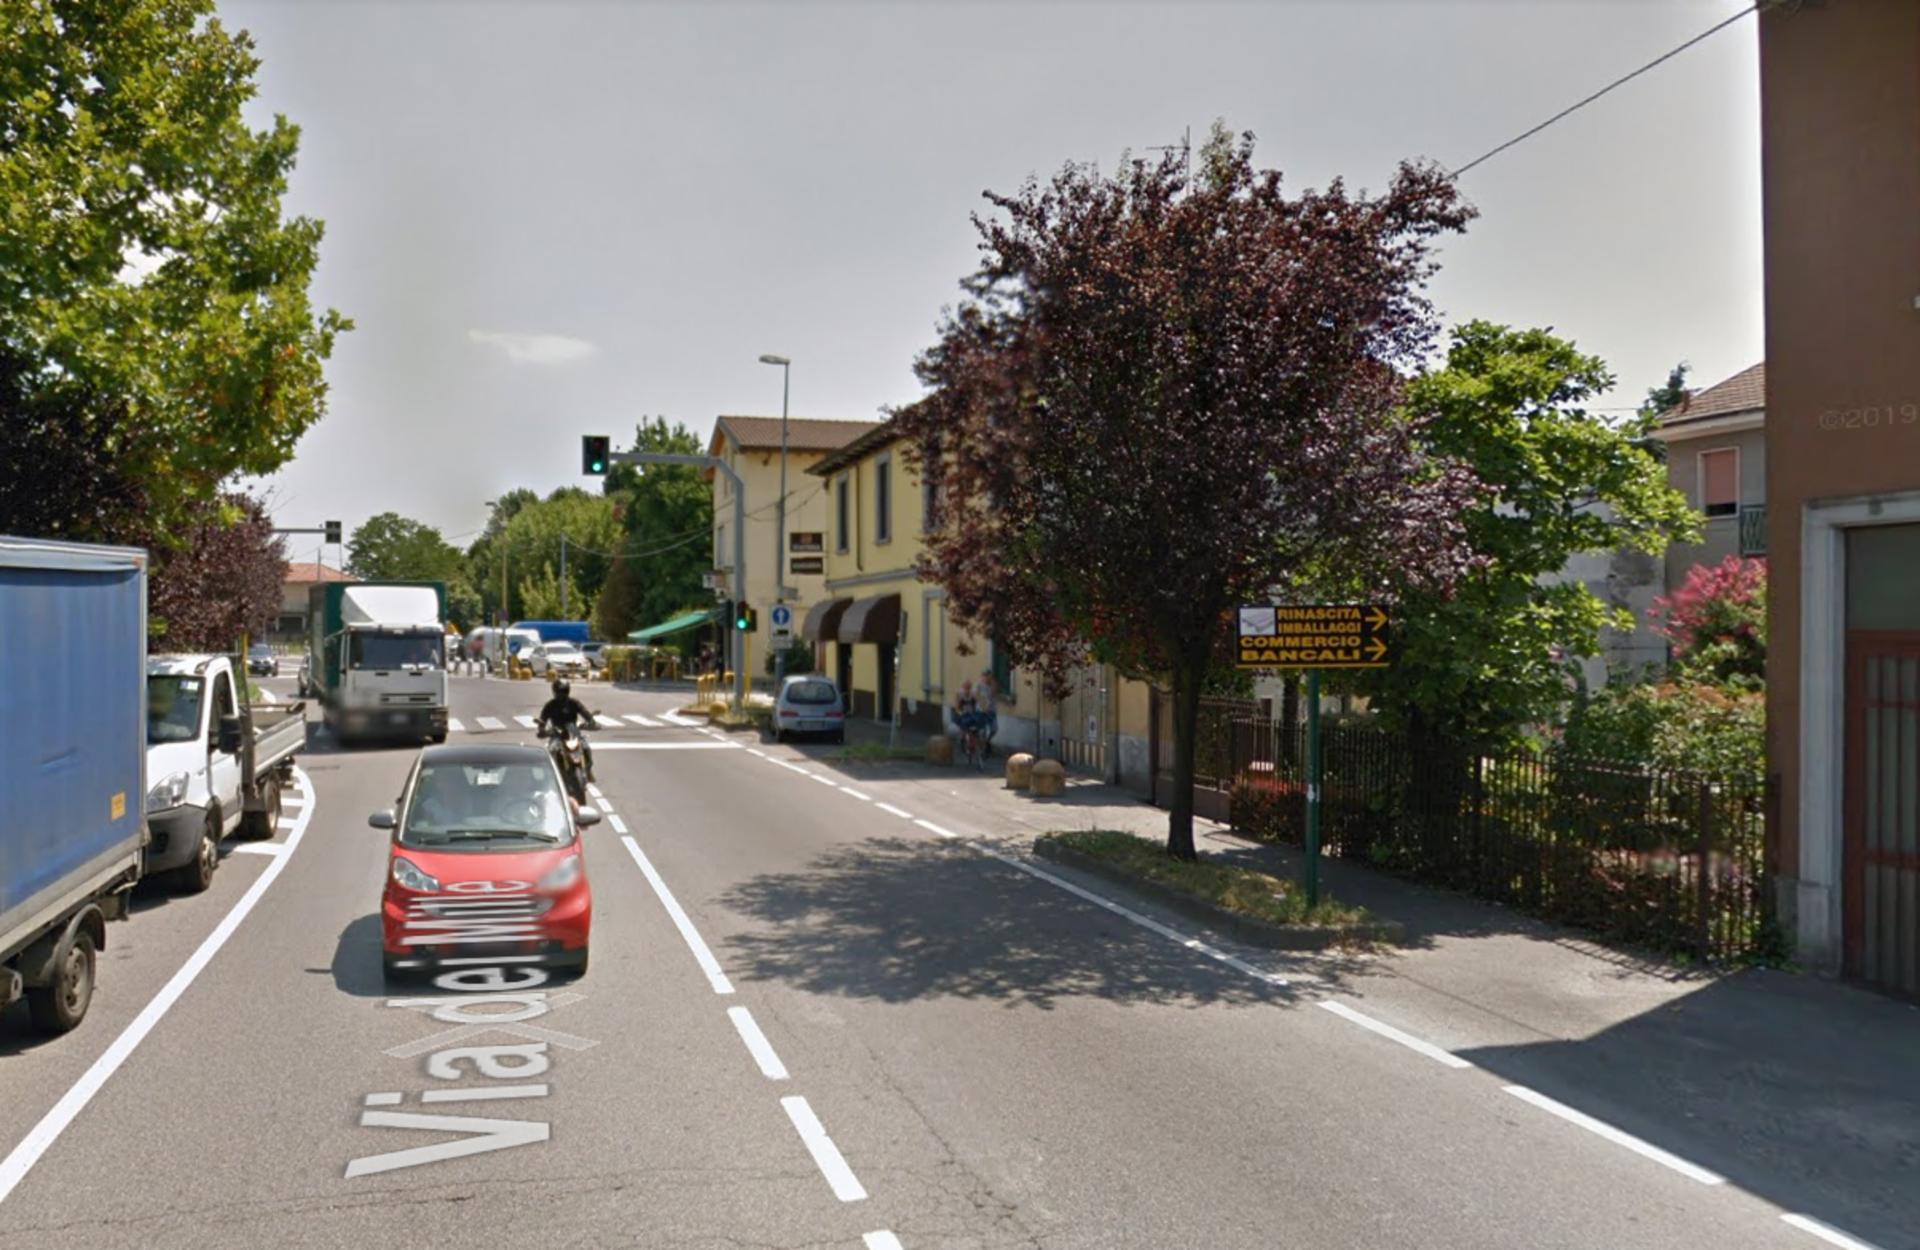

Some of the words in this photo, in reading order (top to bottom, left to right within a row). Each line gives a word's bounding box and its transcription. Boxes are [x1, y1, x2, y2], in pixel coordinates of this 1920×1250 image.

[1277, 608, 1362, 620] RINASCITA
[1278, 622, 1362, 634] IMBALLAGGI
[1240, 636, 1362, 648] COMMERCIO
[1241, 650, 1361, 661] BANCALI
